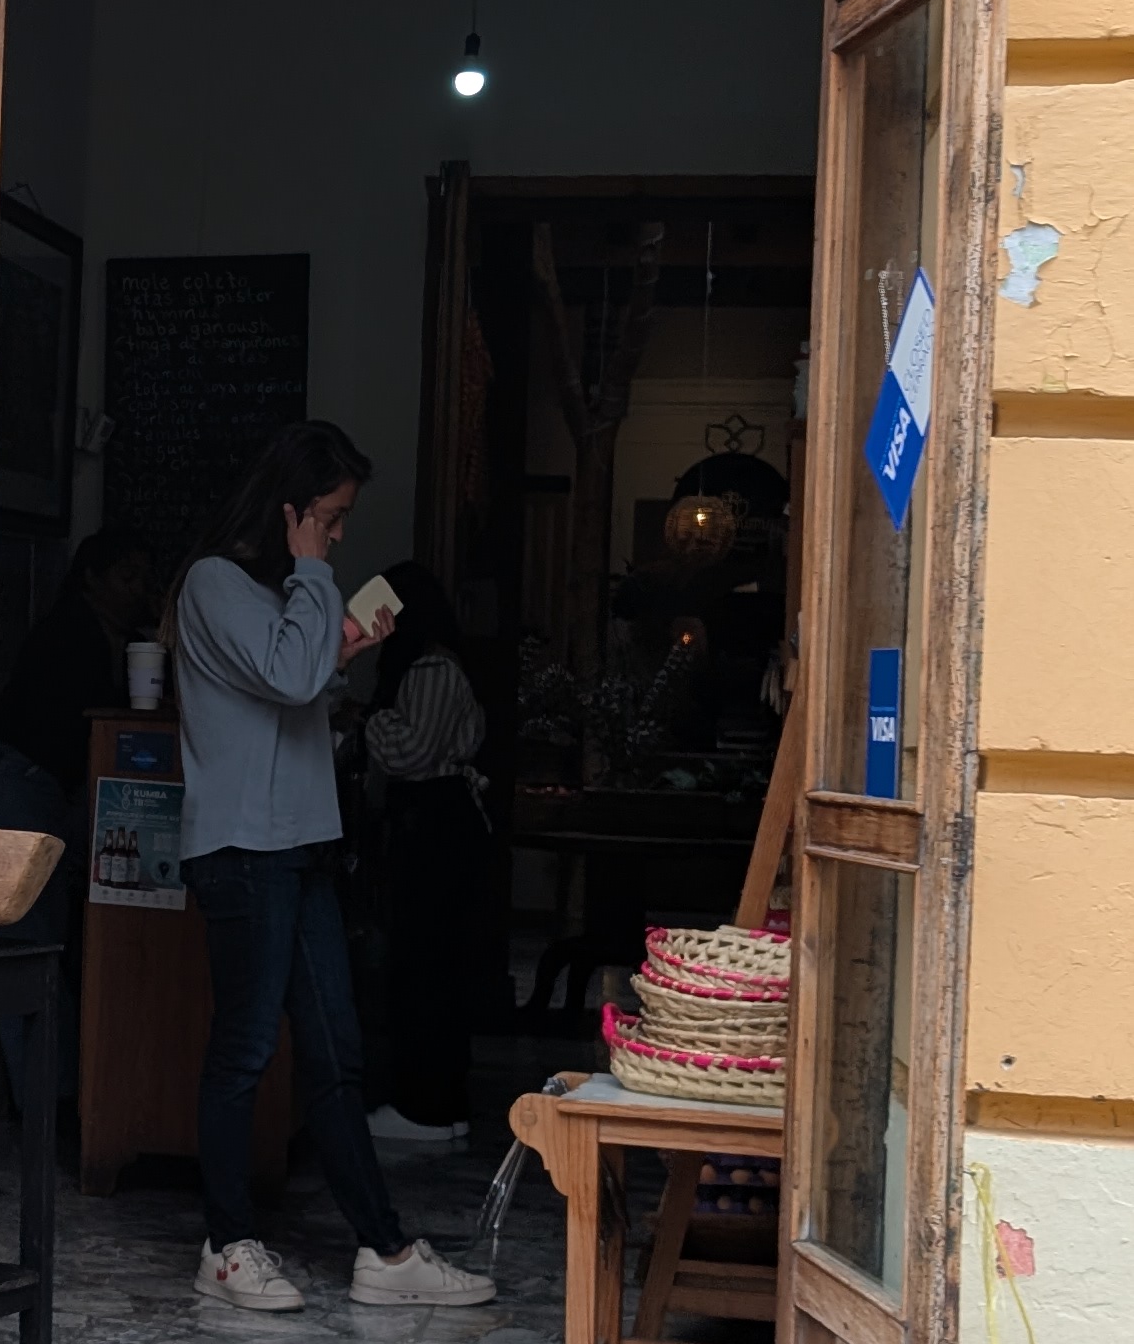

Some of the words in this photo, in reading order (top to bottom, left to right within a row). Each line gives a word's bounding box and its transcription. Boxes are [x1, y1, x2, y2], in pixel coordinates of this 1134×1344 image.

[122, 272, 171, 293] mole
[136, 321, 178, 337] baba
[882, 407, 912, 481] VISA
[870, 716, 896, 743] VISA
